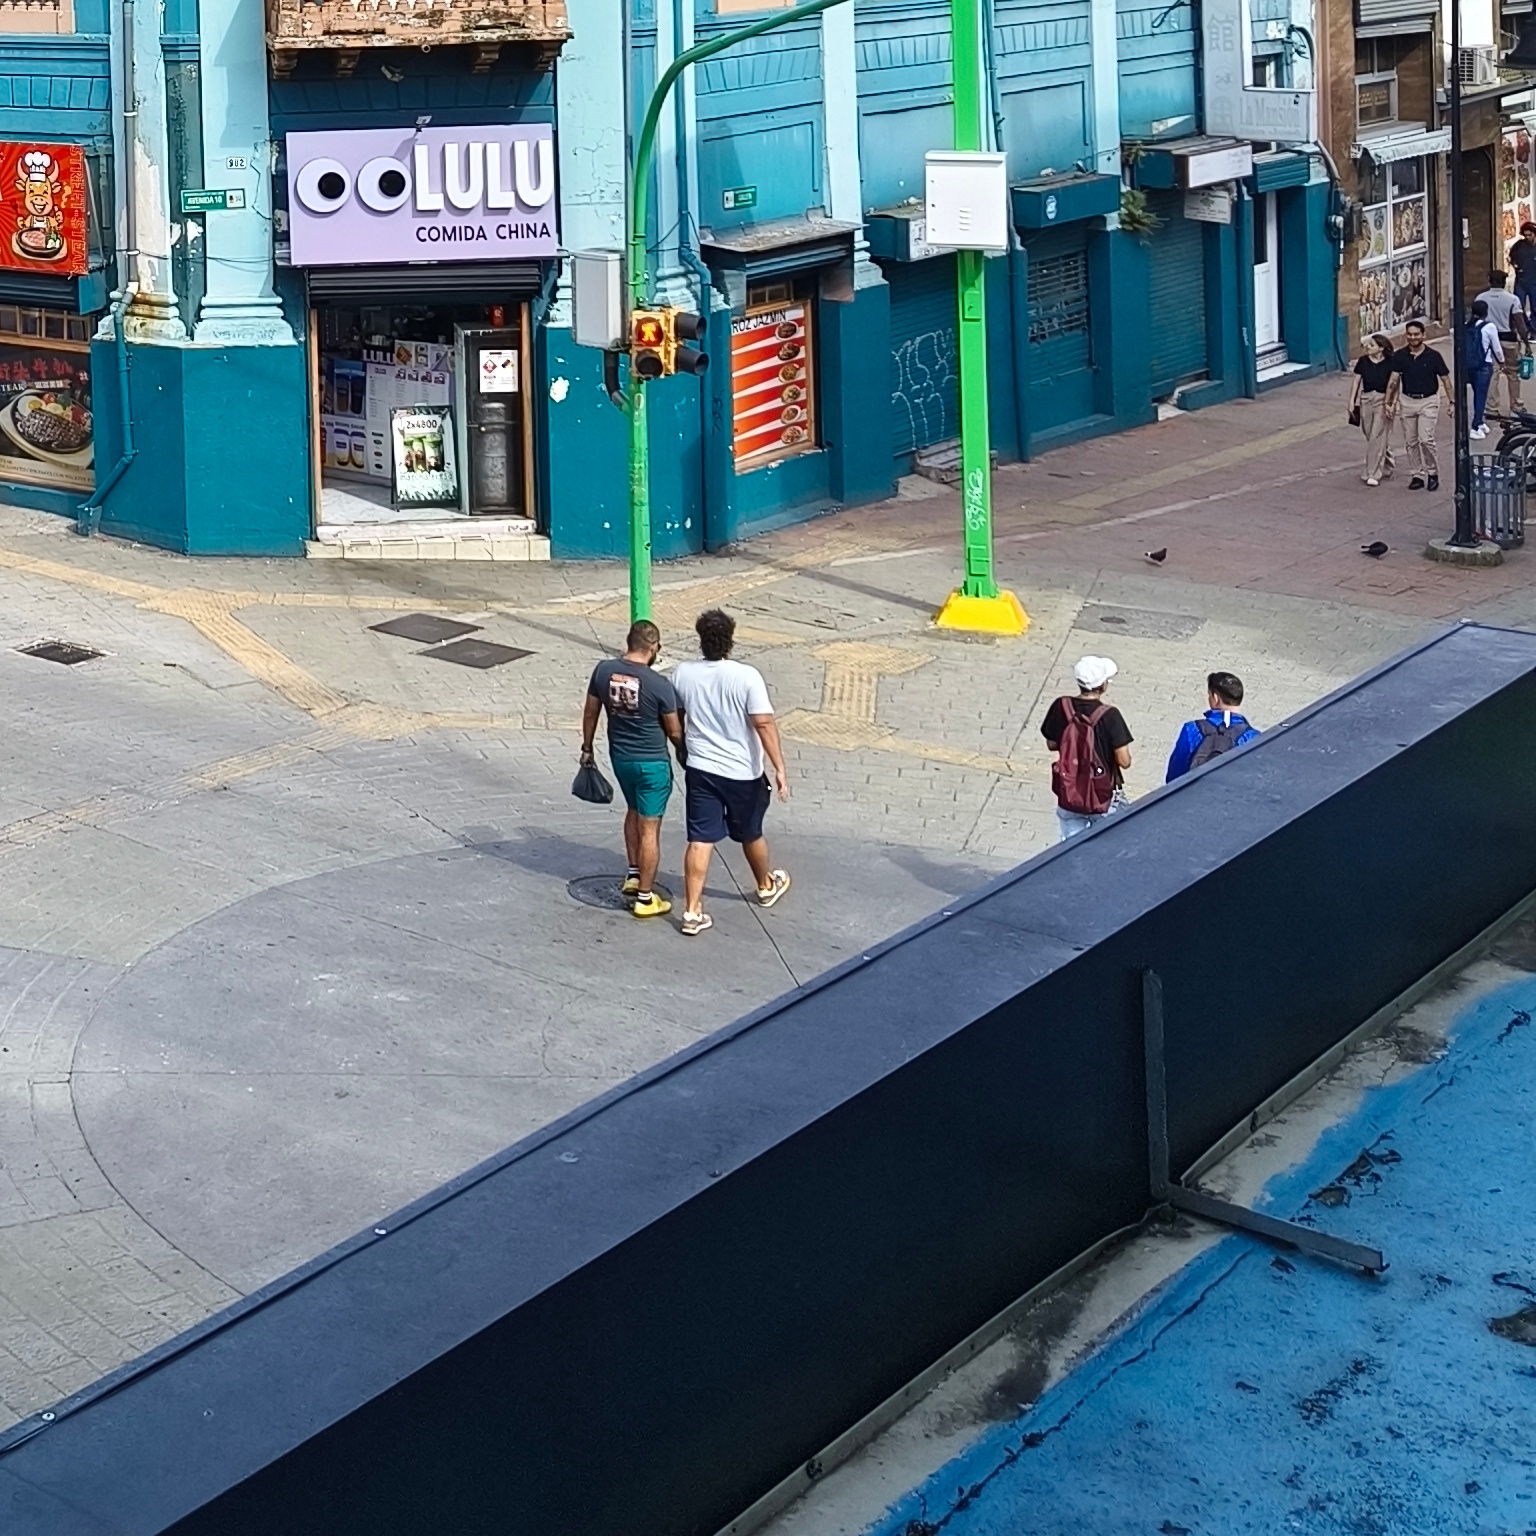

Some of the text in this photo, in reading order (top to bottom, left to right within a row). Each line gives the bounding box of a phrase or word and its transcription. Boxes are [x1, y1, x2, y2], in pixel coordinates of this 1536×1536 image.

[414, 139, 554, 211] LULU
[416, 222, 551, 243] COMIDA CHINA
[363, 349, 396, 365] LULU
